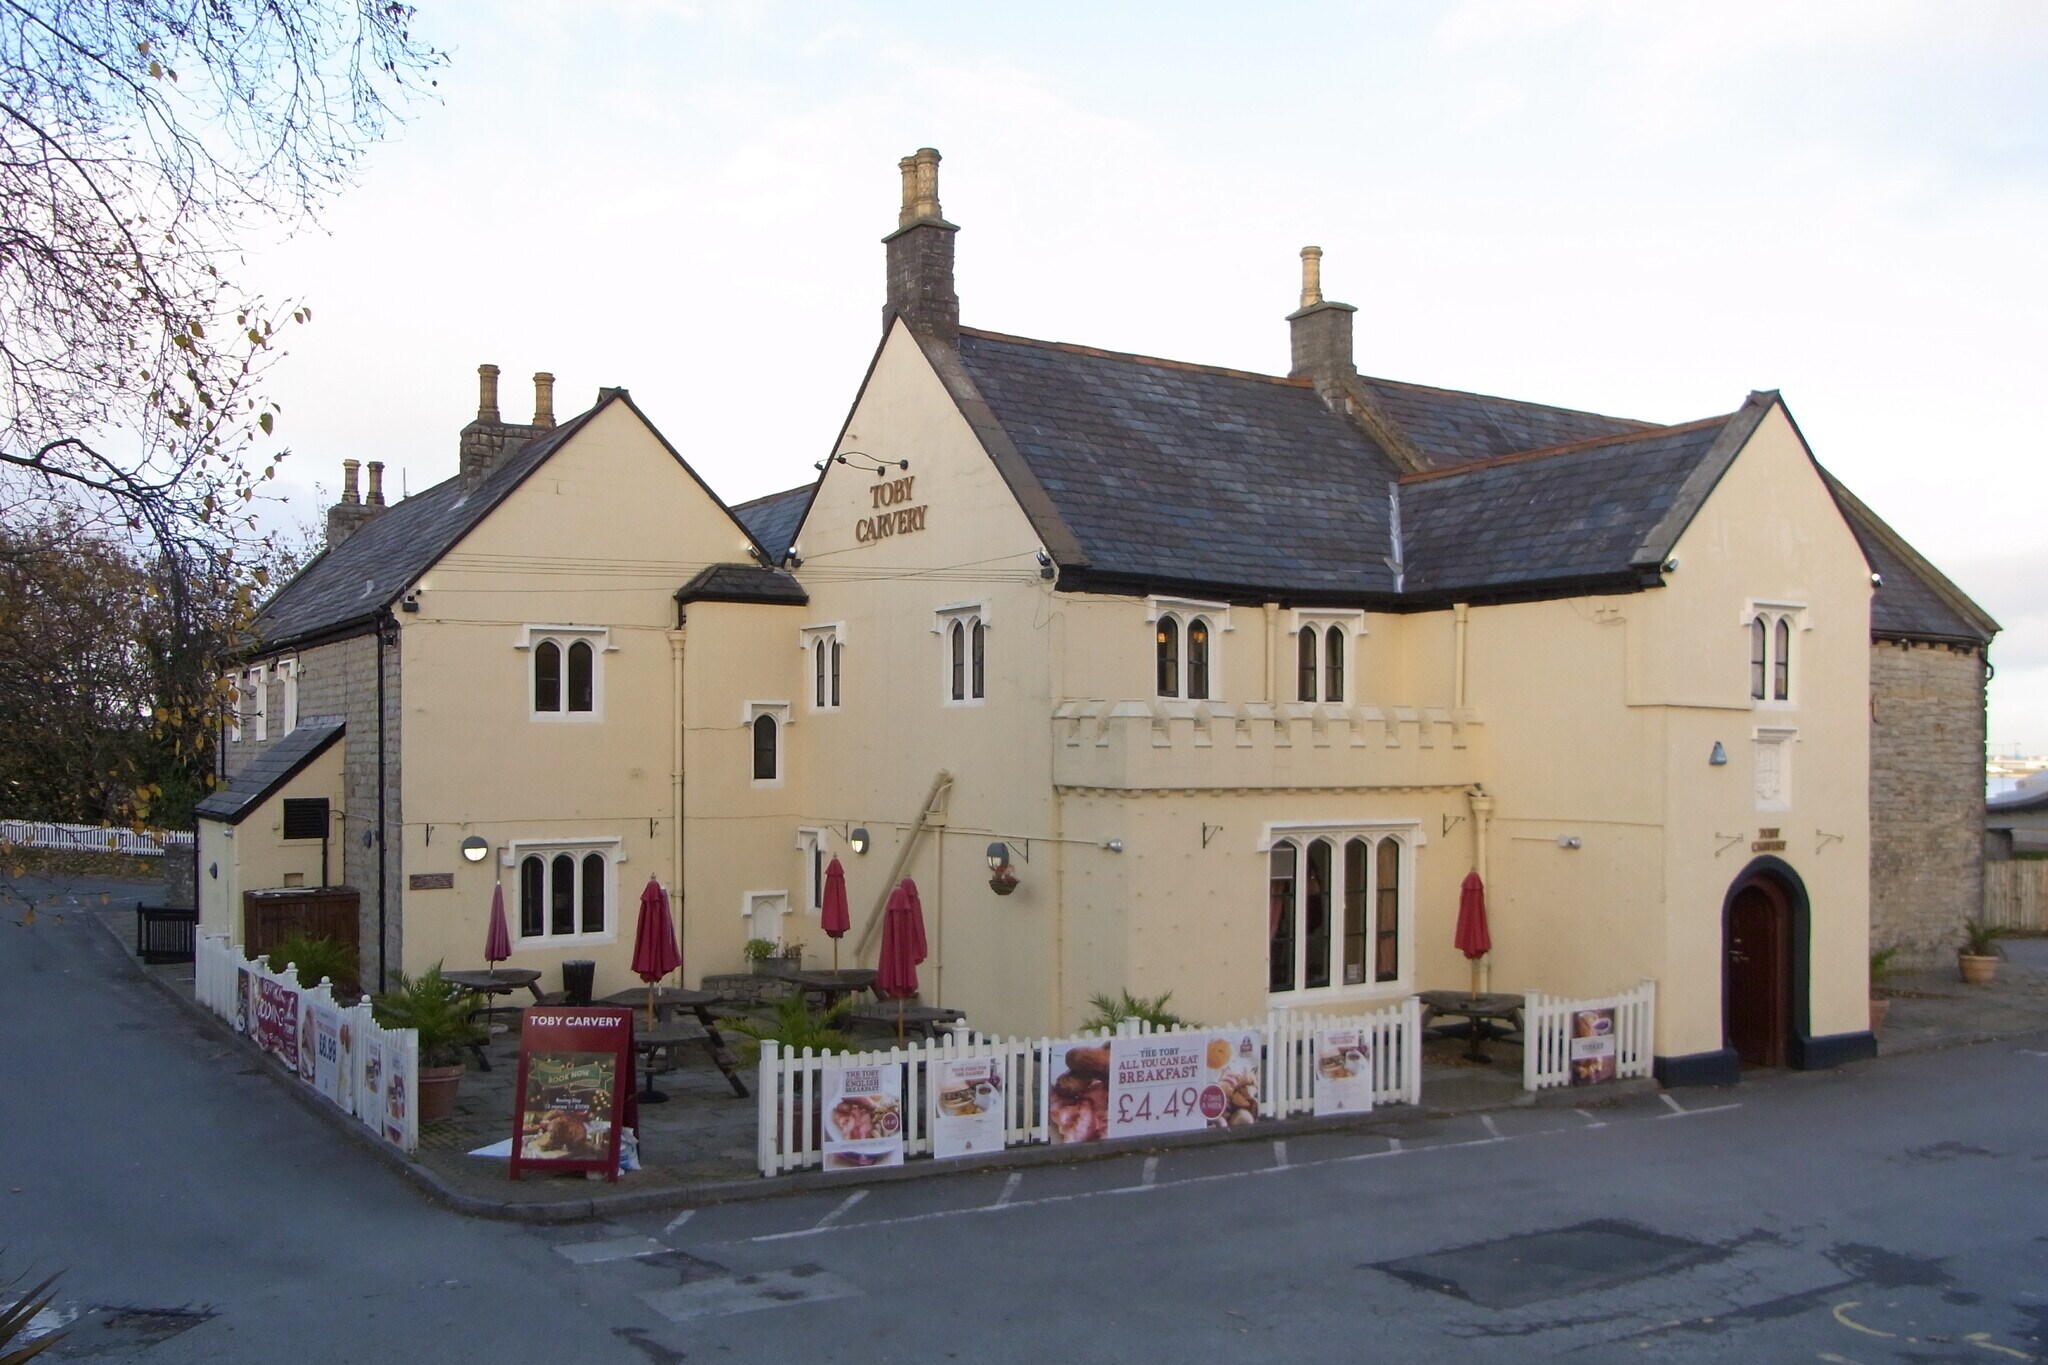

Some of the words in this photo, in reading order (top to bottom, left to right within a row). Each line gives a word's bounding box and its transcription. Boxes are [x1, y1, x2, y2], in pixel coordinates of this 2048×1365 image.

[870, 476, 915, 508] TOBY
[855, 505, 928, 543] CARVERY
[530, 1016, 563, 1026] TOBY
[565, 1016, 621, 1027] CARVERY
[1140, 1049, 1157, 1058] THE
[1159, 1047, 1179, 1056] TOBY
[1119, 1060, 1138, 1070] ALL
[1141, 1058, 1159, 1068] YOU
[1160, 1057, 1179, 1066] CAN
[1180, 1055, 1198, 1065] EAT
[548, 1073, 569, 1083] BOOK
[571, 1070, 589, 1078] NOW
[1118, 1066, 1198, 1084] BREAKFAST
[845, 1079, 879, 1088] ENGLISH
[1117, 1087, 1198, 1124] £4.49
